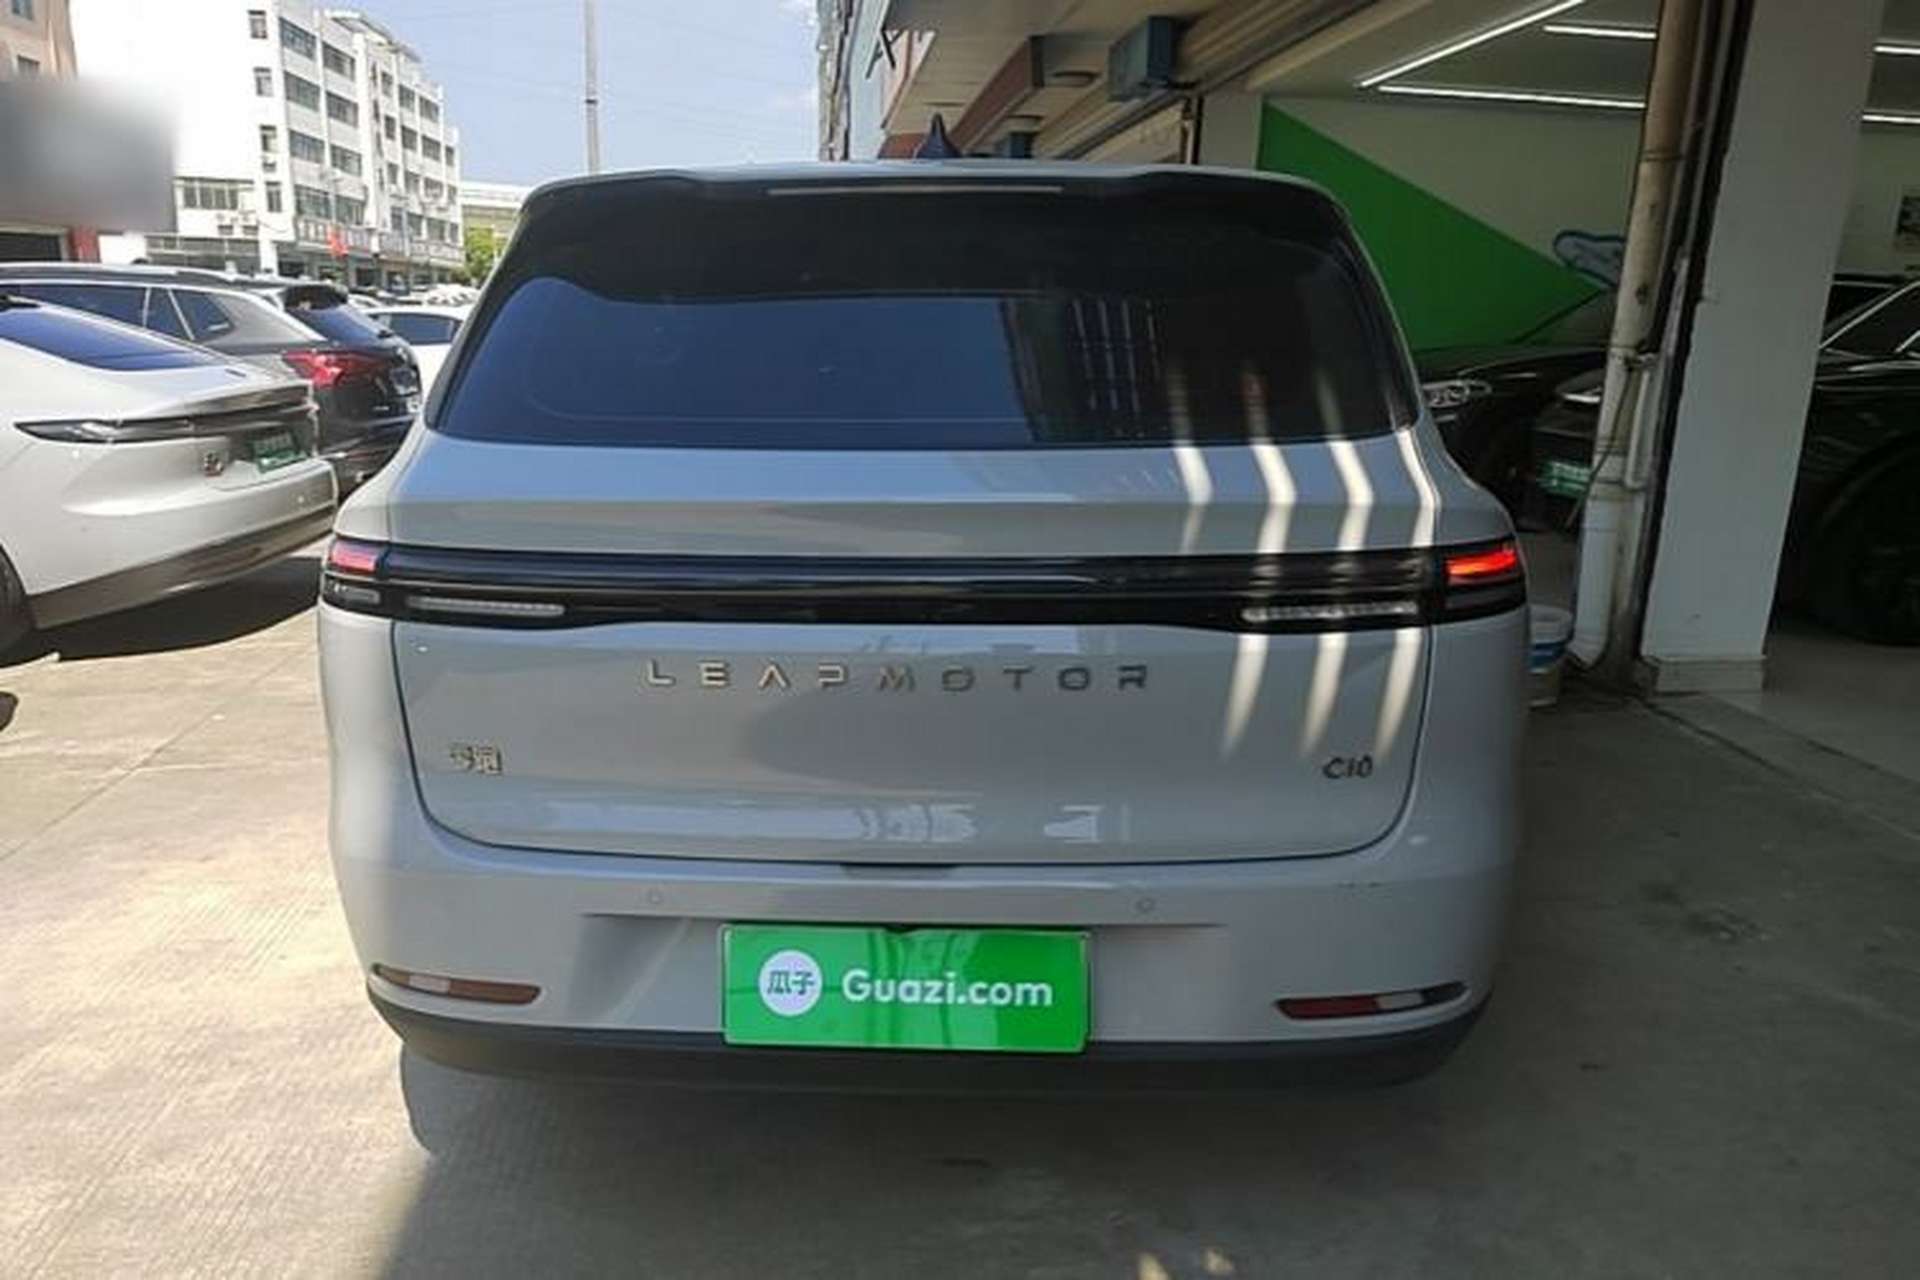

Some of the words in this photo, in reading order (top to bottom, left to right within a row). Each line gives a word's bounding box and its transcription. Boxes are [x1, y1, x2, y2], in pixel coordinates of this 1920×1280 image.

[645, 659, 1150, 692] LEAPMOTOR
[1322, 754, 1373, 779] C10
[767, 970, 815, 996] 瓜子
[841, 969, 1053, 1006] Guazi.com
